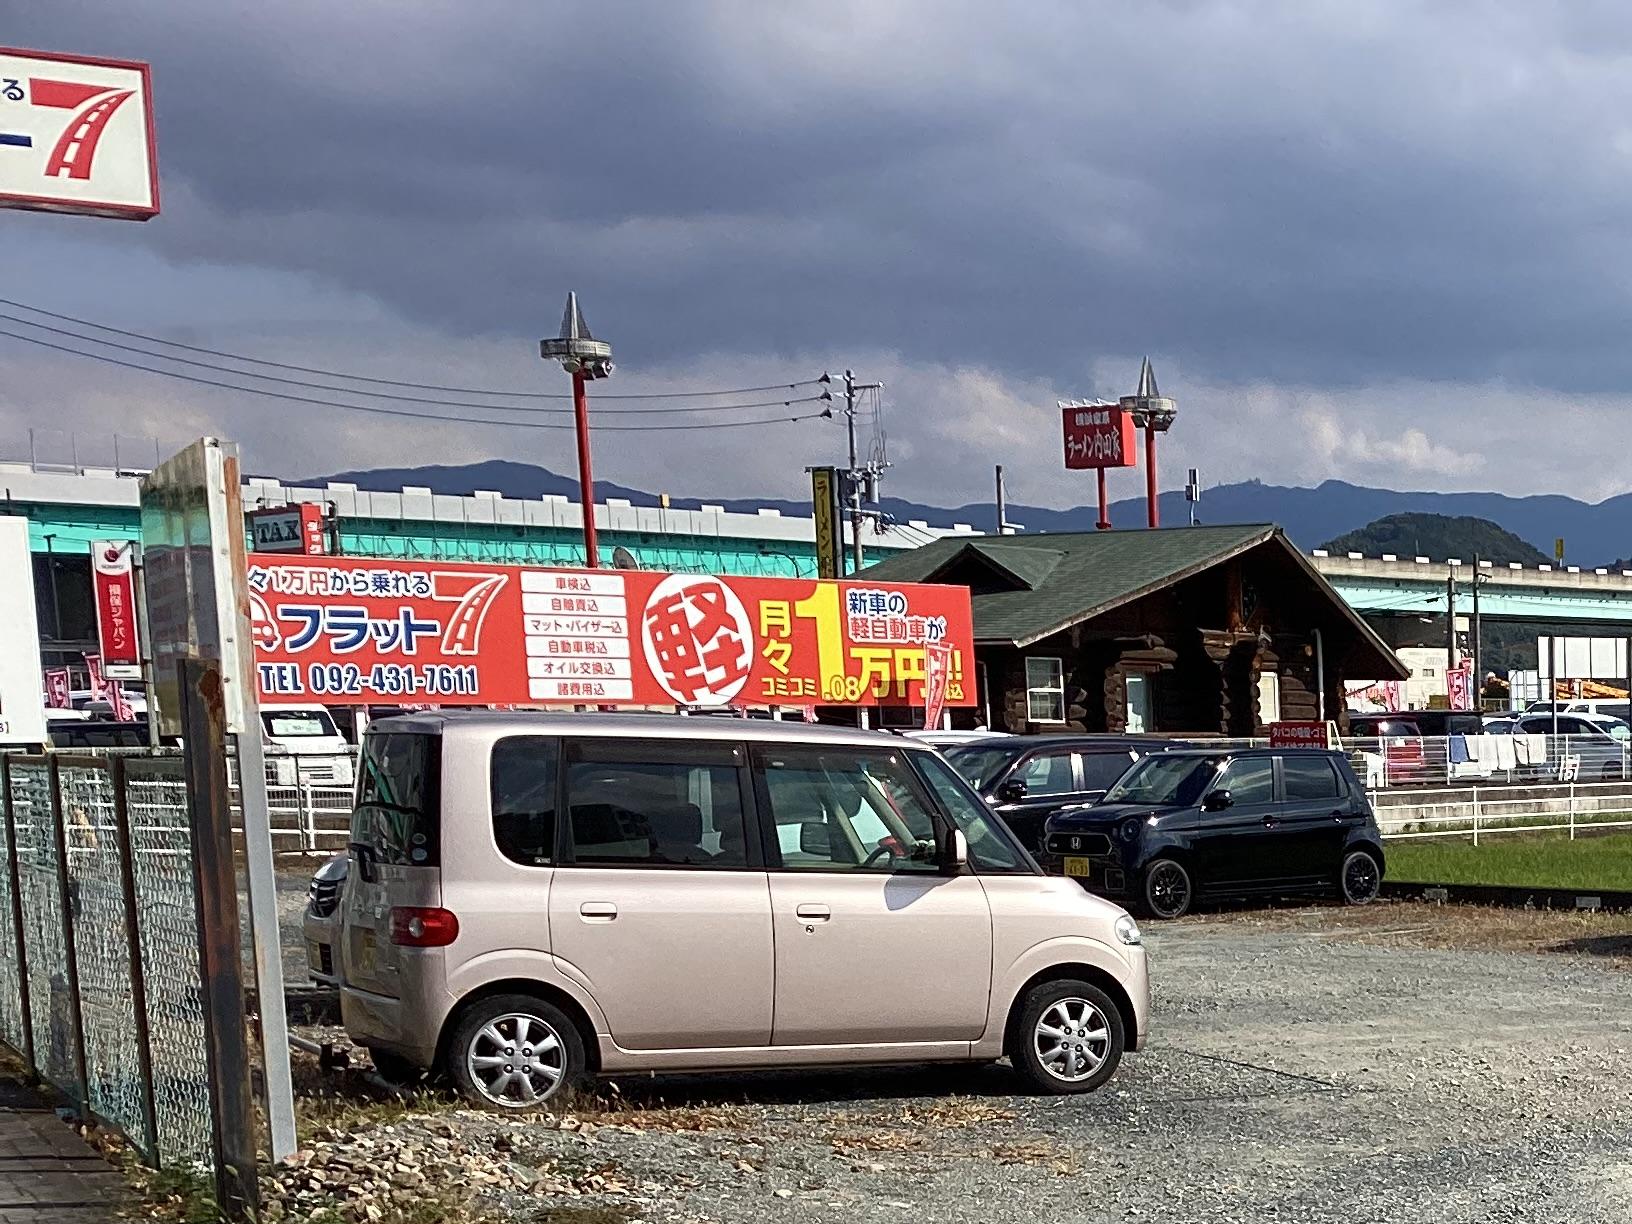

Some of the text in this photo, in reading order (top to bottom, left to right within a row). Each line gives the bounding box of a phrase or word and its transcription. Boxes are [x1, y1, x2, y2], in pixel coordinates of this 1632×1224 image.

[256, 519, 300, 543] TAX
[555, 577, 591, 591] 車検込
[849, 591, 906, 615] 新車の
[279, 605, 439, 654] フラット
[850, 616, 945, 641] 軽自動車が
[548, 640, 608, 654] 自動車税込
[646, 582, 750, 701] 軽
[259, 664, 479, 694] TEL 092-431-7611
[544, 661, 615, 675] オイル交換込
[557, 682, 605, 696] 諸費用込
[761, 677, 817, 697] コミコミ
